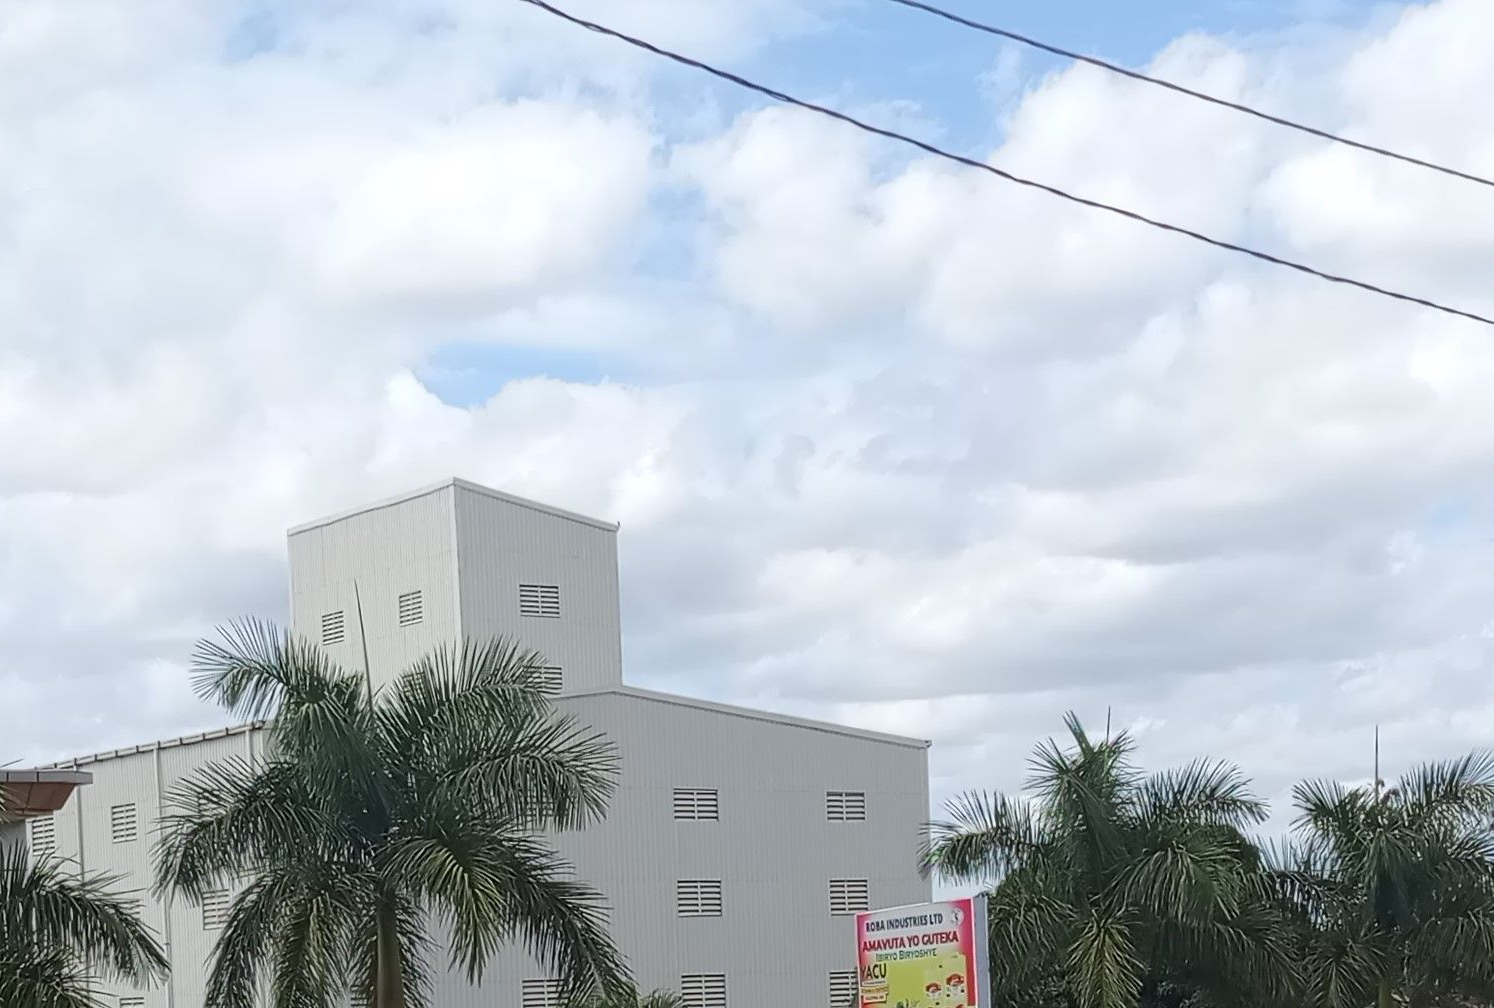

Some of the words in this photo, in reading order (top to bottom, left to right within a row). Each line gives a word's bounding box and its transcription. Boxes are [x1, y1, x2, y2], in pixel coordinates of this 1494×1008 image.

[865, 919, 886, 933] ROBA
[886, 914, 928, 930] INDUSTRIES
[929, 913, 944, 925] LTD
[906, 935, 920, 948] YO
[921, 931, 959, 945] GUTEKA
[860, 963, 887, 979] YACU
